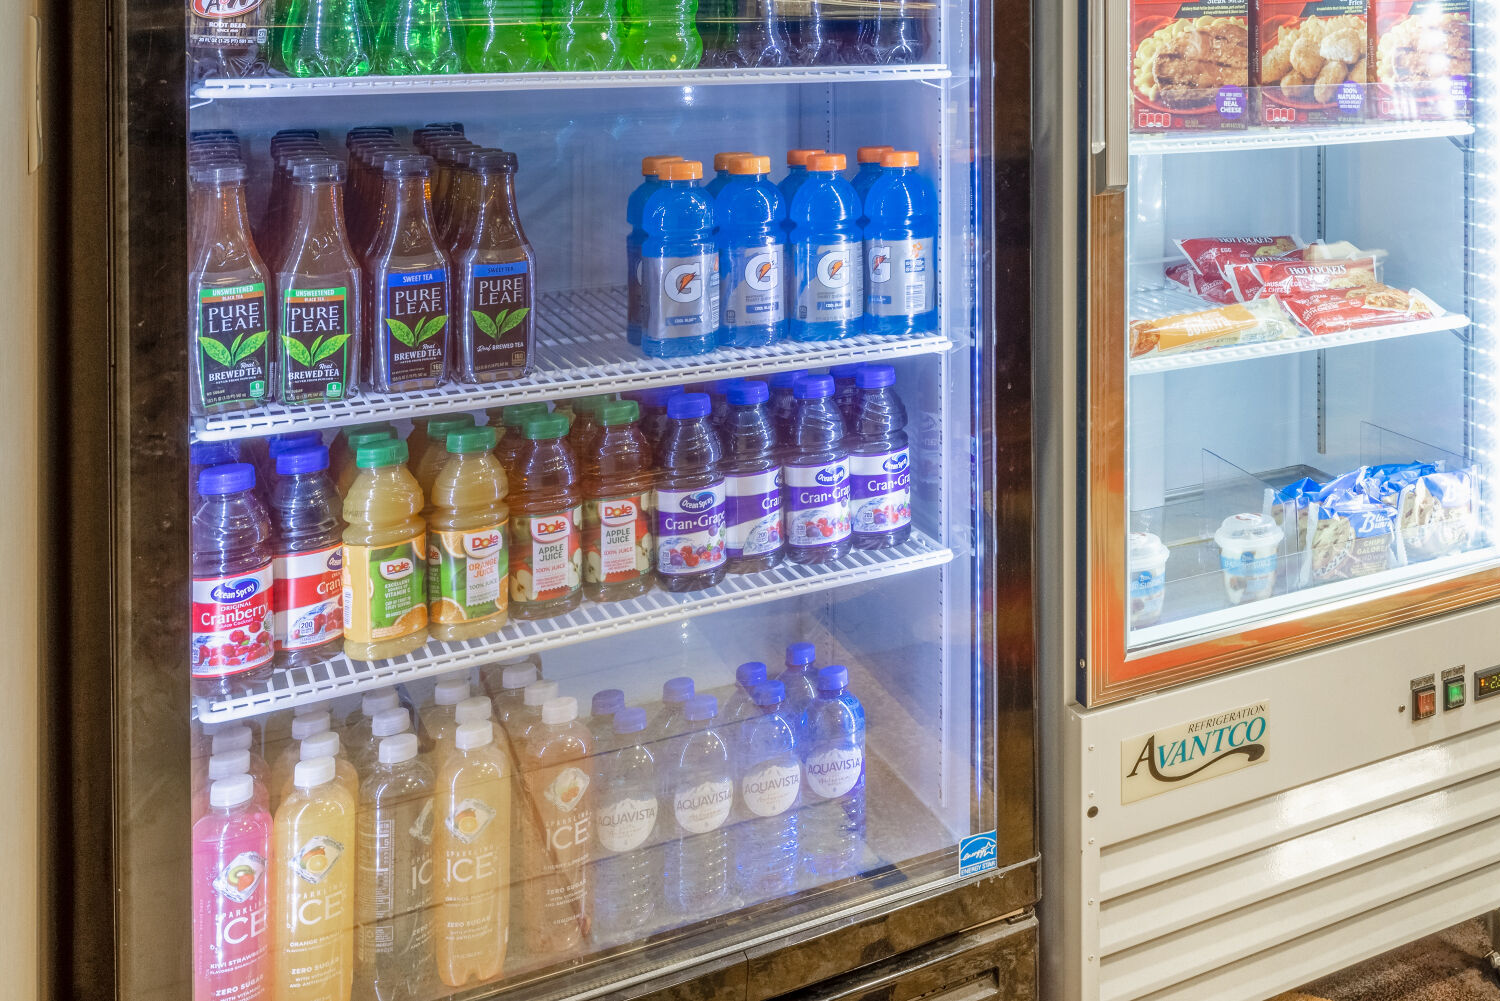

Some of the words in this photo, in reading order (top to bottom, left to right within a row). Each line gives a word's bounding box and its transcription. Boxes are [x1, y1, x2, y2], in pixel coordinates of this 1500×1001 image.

[1289, 266, 1306, 275] HOT
[1307, 264, 1347, 275] POCKETS
[402, 275, 421, 283] SWEET
[479, 278, 522, 293] PURE
[212, 285, 254, 296] UNSWEETENED
[395, 288, 441, 303] PURE
[479, 291, 522, 305] LEAF
[209, 303, 260, 320] PURE
[291, 306, 339, 320] PURE
[395, 300, 442, 316] LEAF
[209, 315, 261, 333] LEAF
[291, 318, 340, 333] LEAF
[394, 350, 427, 362] BREWED
[428, 349, 442, 357] TEA
[208, 368, 245, 382] BREWED
[246, 367, 262, 376] TEA
[289, 369, 322, 380] BREWED
[324, 369, 340, 377] TEA
[681, 500, 698, 509] Ocean
[698, 496, 714, 508] Spray
[604, 505, 632, 519] Dole
[537, 520, 566, 534] Dole
[606, 528, 631, 538] APPLE
[472, 532, 499, 549] Dole
[606, 535, 630, 545] JUICE
[539, 544, 564, 555] APPLE
[539, 551, 563, 562] JUICE
[387, 560, 410, 575] Dole
[469, 558, 497, 572] ORANGE
[473, 567, 495, 578] JUICE
[213, 587, 235, 599] Ocean
[235, 583, 255, 599] Spray
[220, 601, 251, 612] ORIGINAL
[201, 603, 268, 626] Cranberry
[1188, 704, 1266, 735] REFRIGERATION
[1126, 716, 1266, 783] AVANTCO
[807, 757, 861, 776] AQUAVISTA
[744, 774, 799, 794] AQUAVISTA
[547, 817, 590, 851] ICE
[960, 866, 981, 876] ENERGY
[982, 861, 997, 871] STAR
